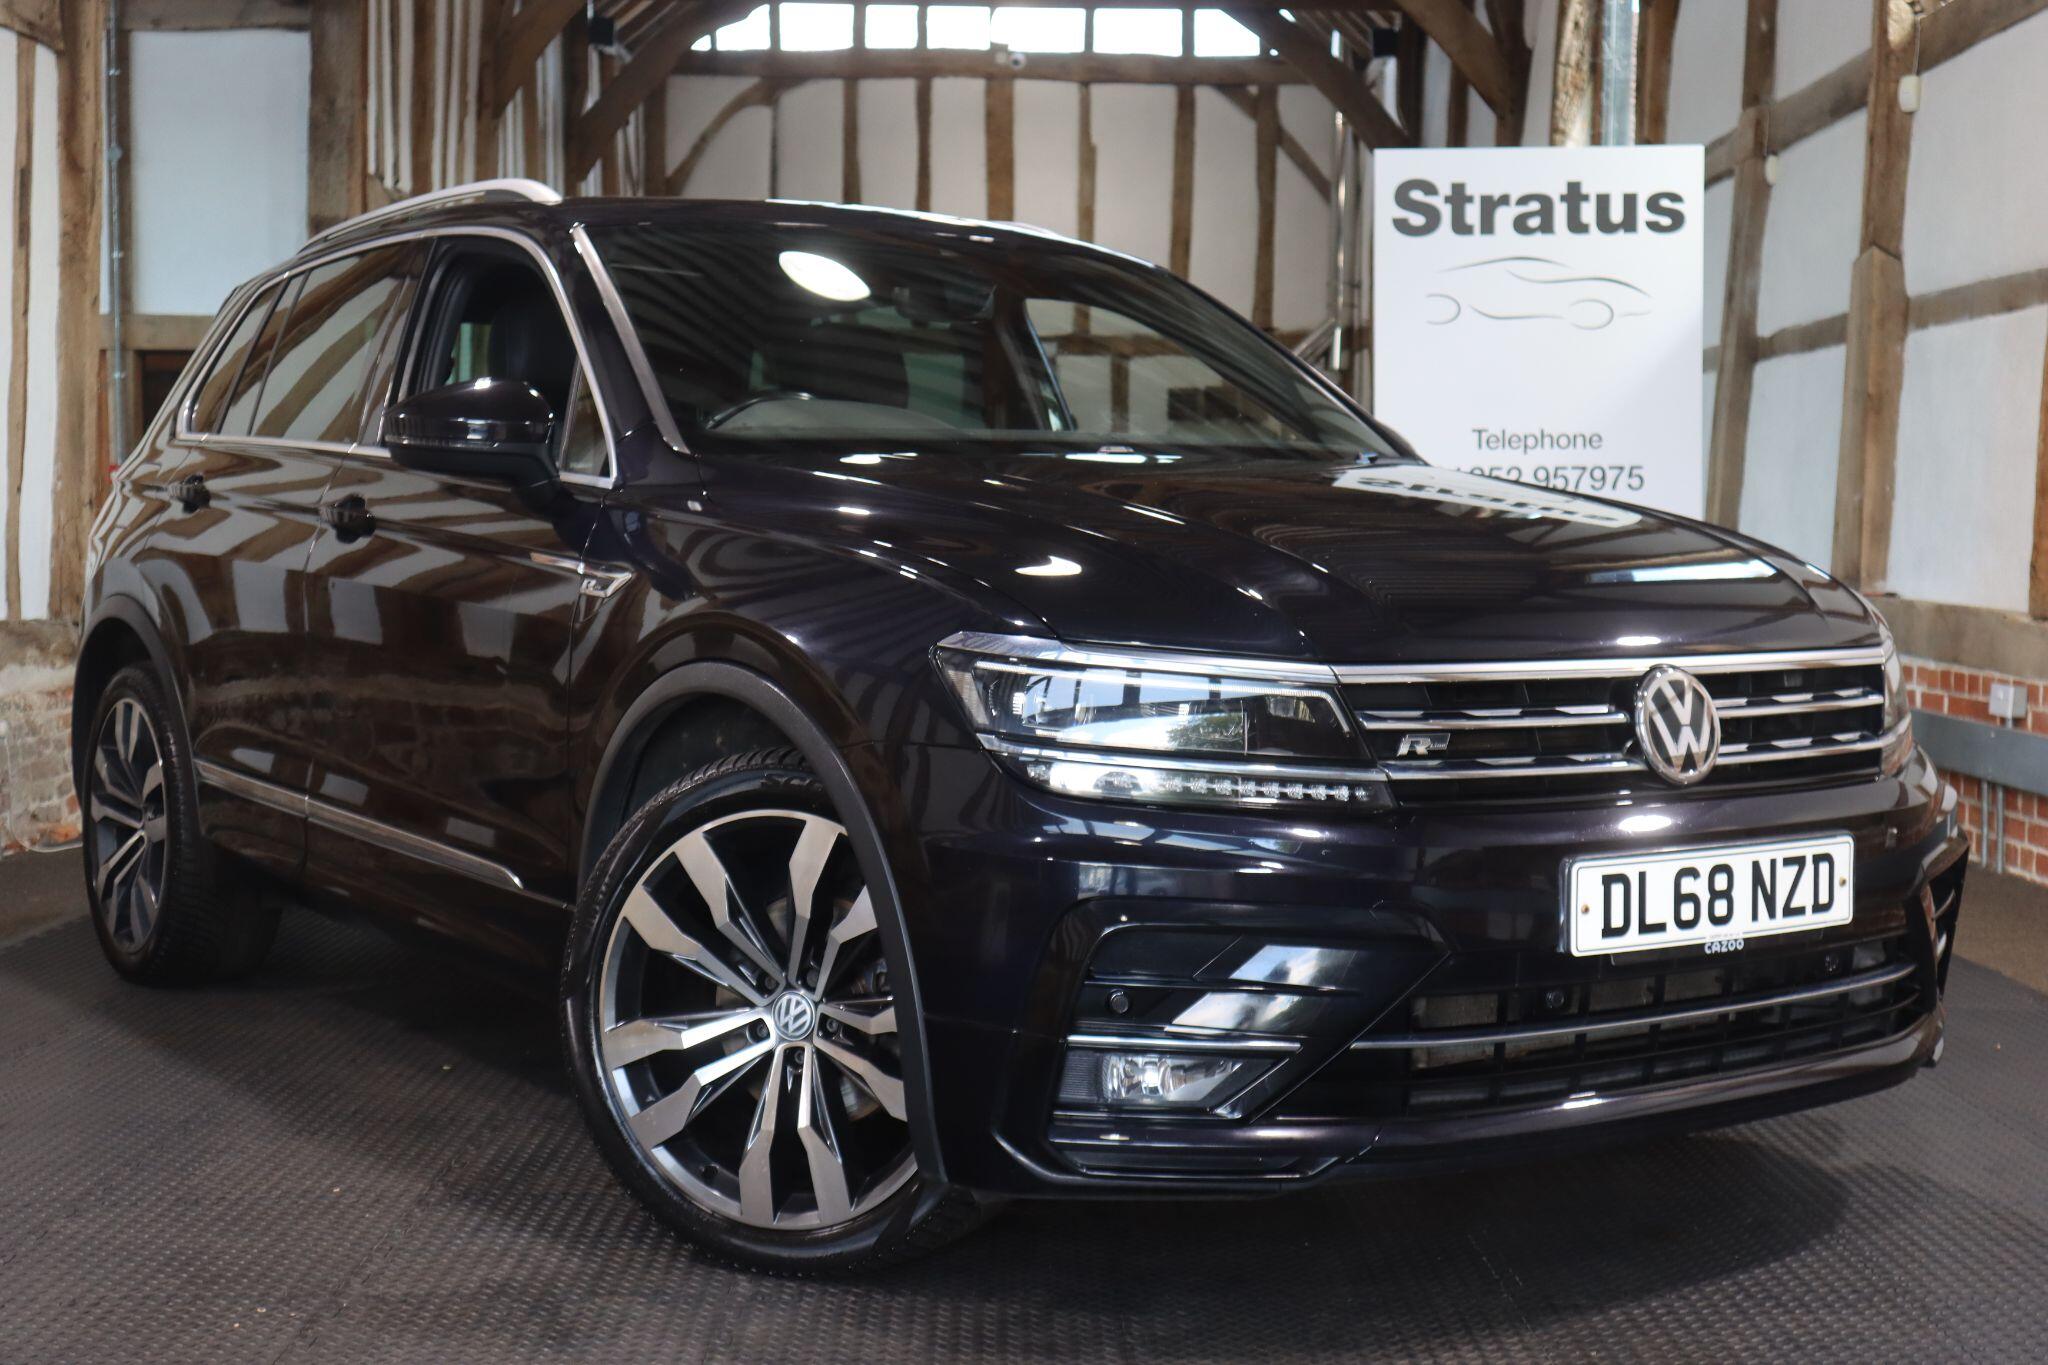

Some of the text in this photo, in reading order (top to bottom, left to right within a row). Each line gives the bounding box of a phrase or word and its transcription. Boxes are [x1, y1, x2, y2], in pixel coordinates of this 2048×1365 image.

[1392, 178, 1686, 237] Stratus
[1472, 428, 1603, 455] Telephone
[1533, 466, 1645, 491] 957975
[1601, 852, 1835, 940] DL68 NZD
[1704, 938, 1745, 955] CAZOO
